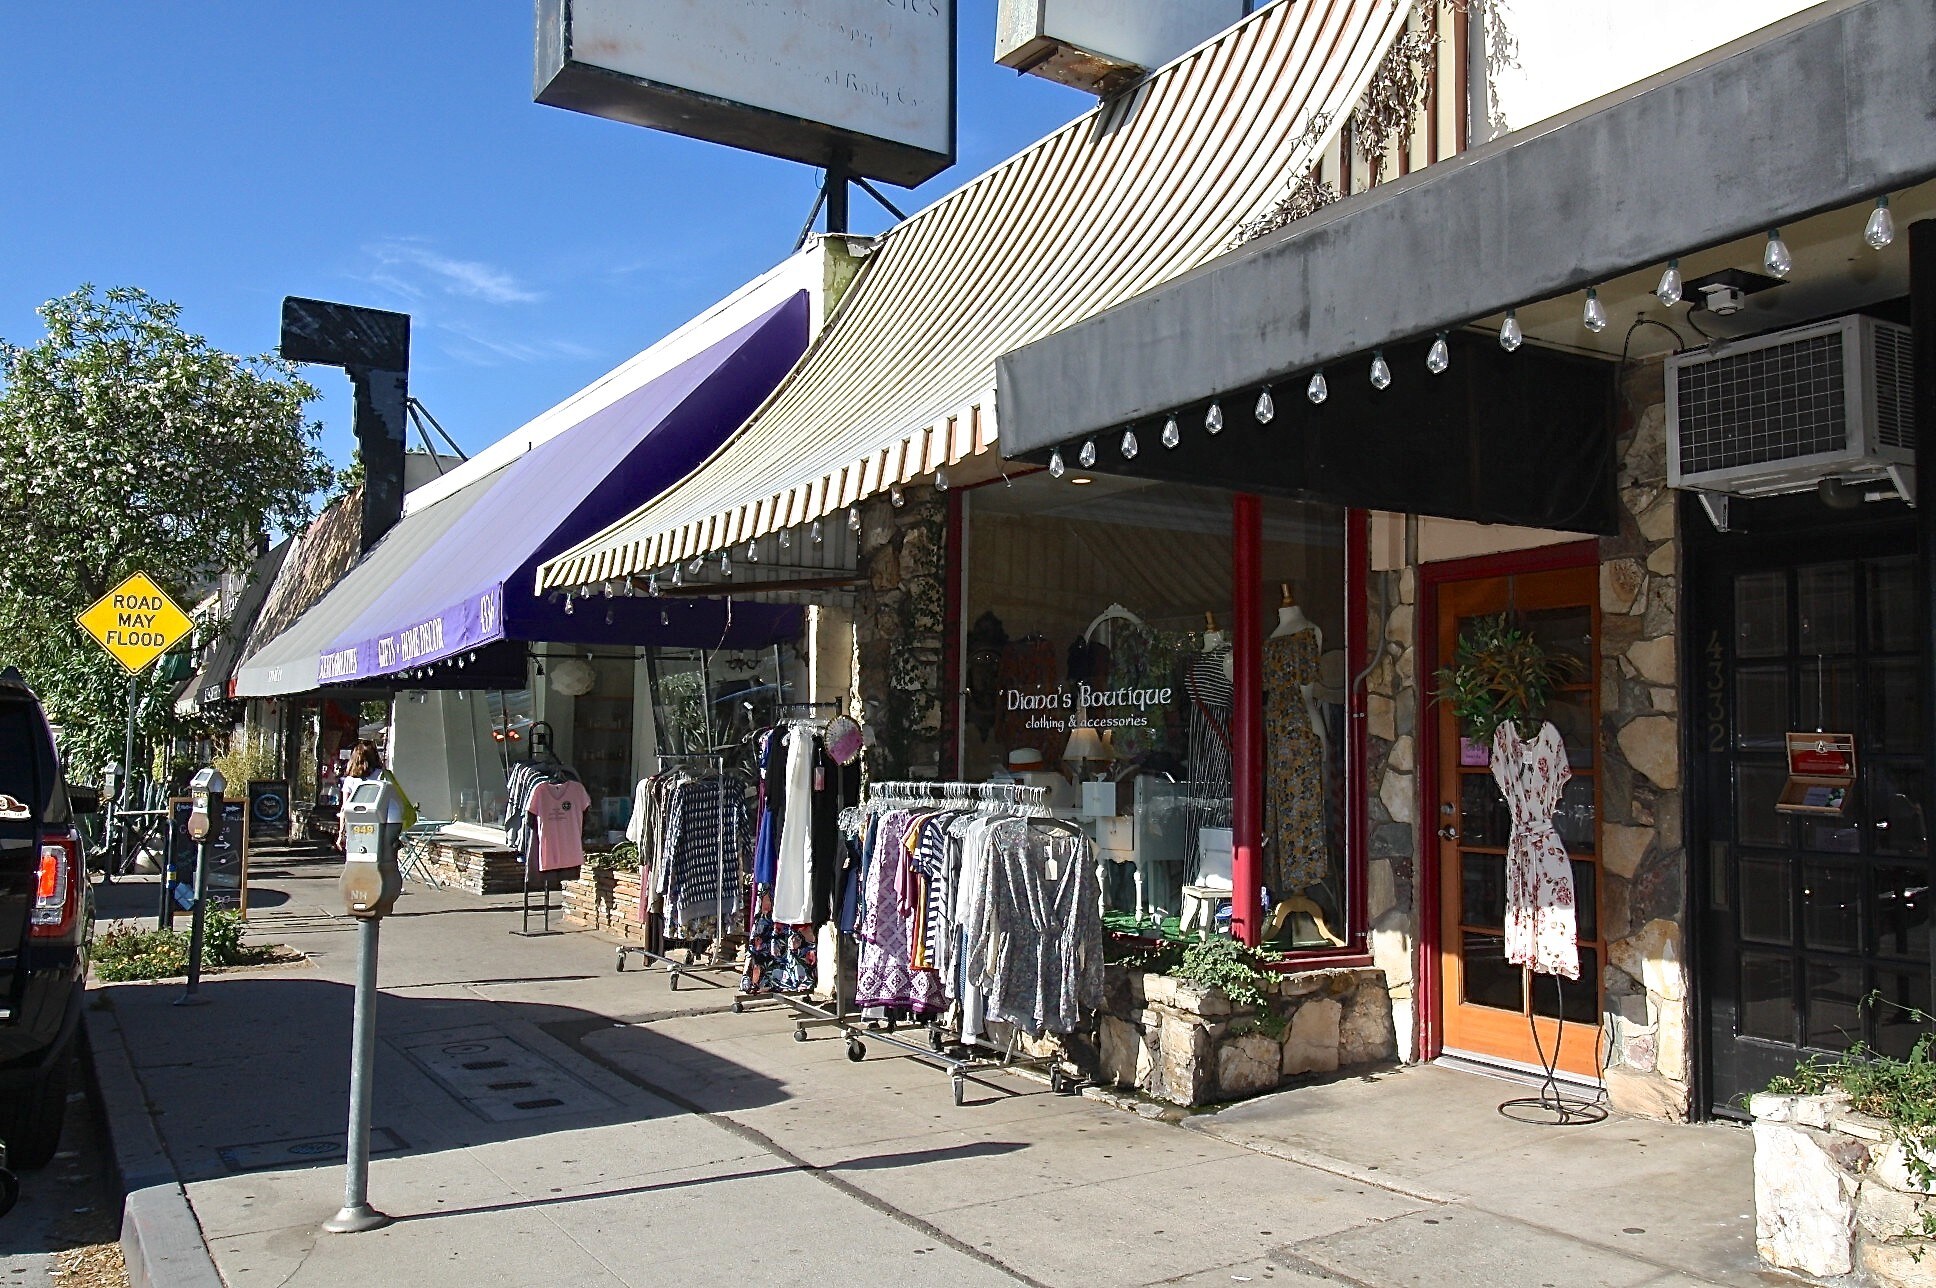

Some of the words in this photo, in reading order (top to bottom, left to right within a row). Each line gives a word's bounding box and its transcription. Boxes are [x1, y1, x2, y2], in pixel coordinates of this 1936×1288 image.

[113, 594, 163, 610] ROAD
[118, 613, 156, 628] MAY
[106, 631, 165, 647] FLOOD
[378, 636, 396, 668] GIFTS
[400, 627, 420, 661] HOME
[419, 617, 445, 656] DECOR
[1007, 685, 1072, 711] Diana's
[1080, 685, 1172, 712] Boutique
[1706, 631, 1724, 752] 4332
[1025, 714, 1064, 732] clothing
[1068, 714, 1077, 729] &
[1080, 714, 1148, 728] accessories
